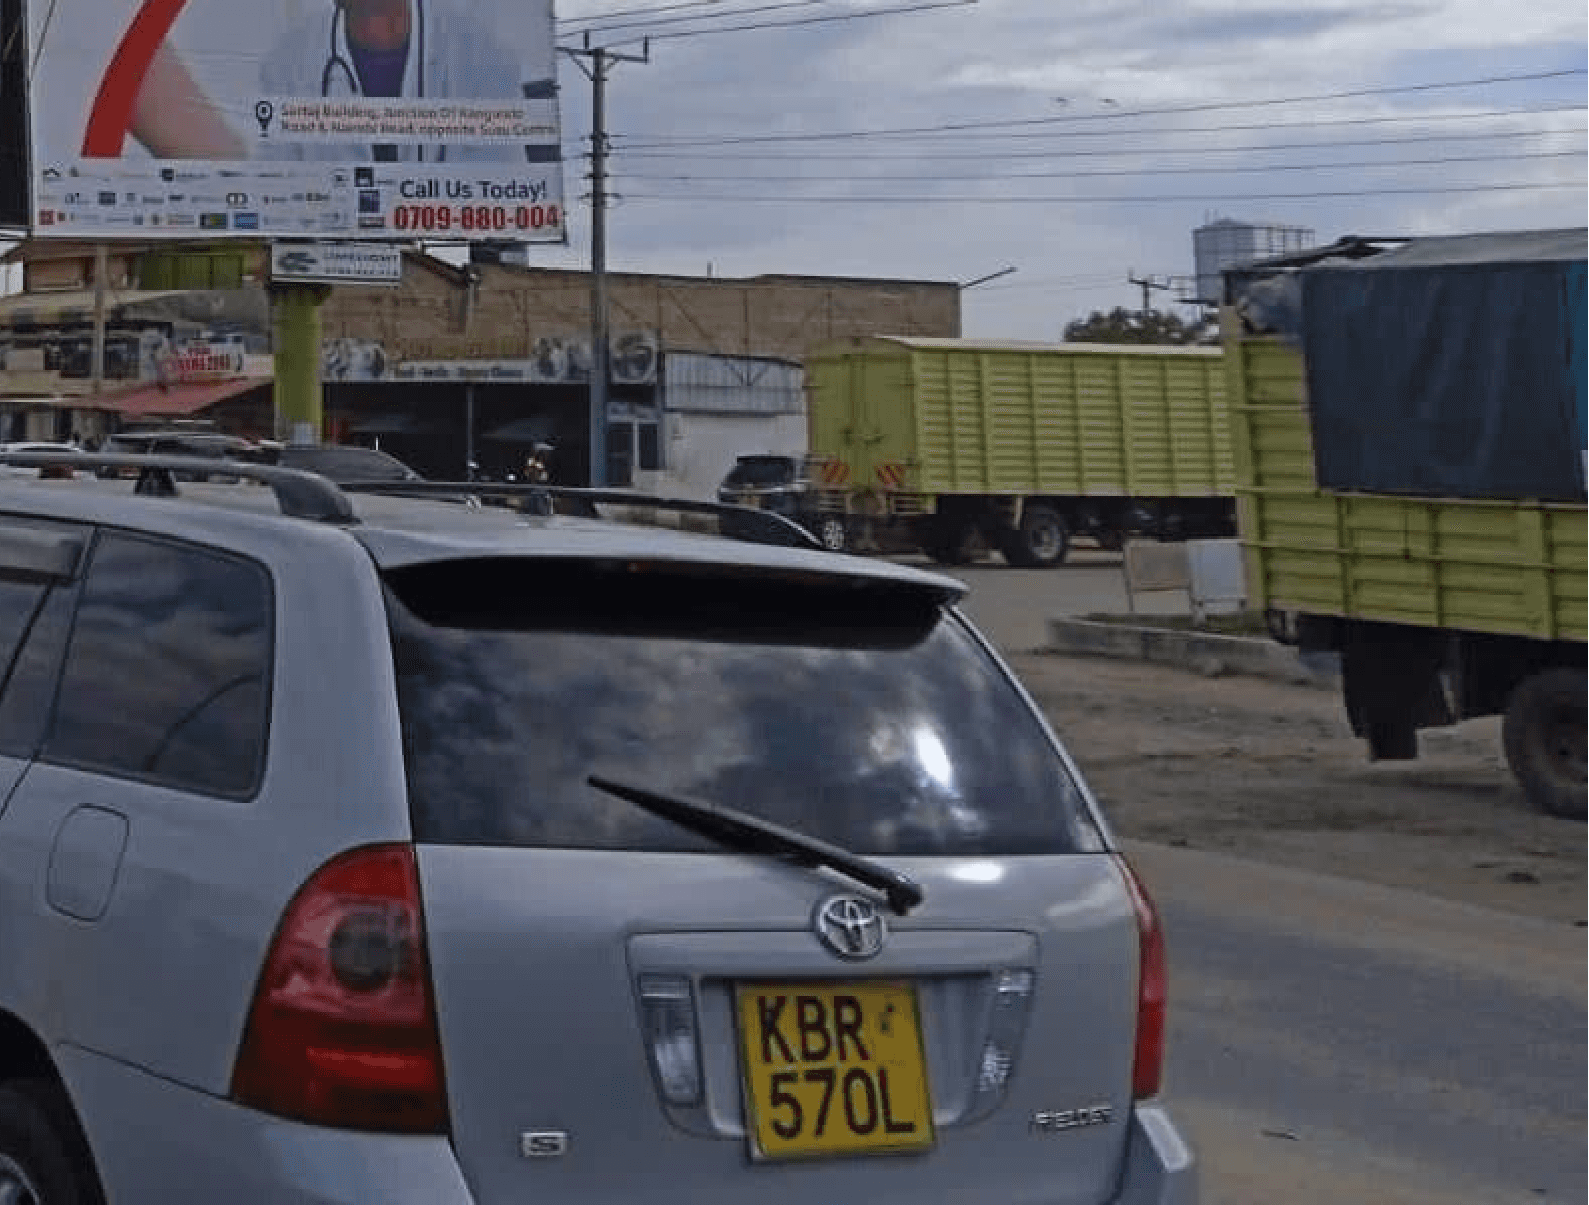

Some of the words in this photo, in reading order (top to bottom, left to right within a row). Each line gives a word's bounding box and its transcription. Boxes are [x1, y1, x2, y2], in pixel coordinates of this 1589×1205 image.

[399, 179, 439, 199] Call
[445, 179, 473, 198] Us
[476, 179, 547, 203] Today!
[393, 204, 560, 231] 0709-880-004
[758, 995, 870, 1064] KBR
[767, 1067, 917, 1140] 570L
